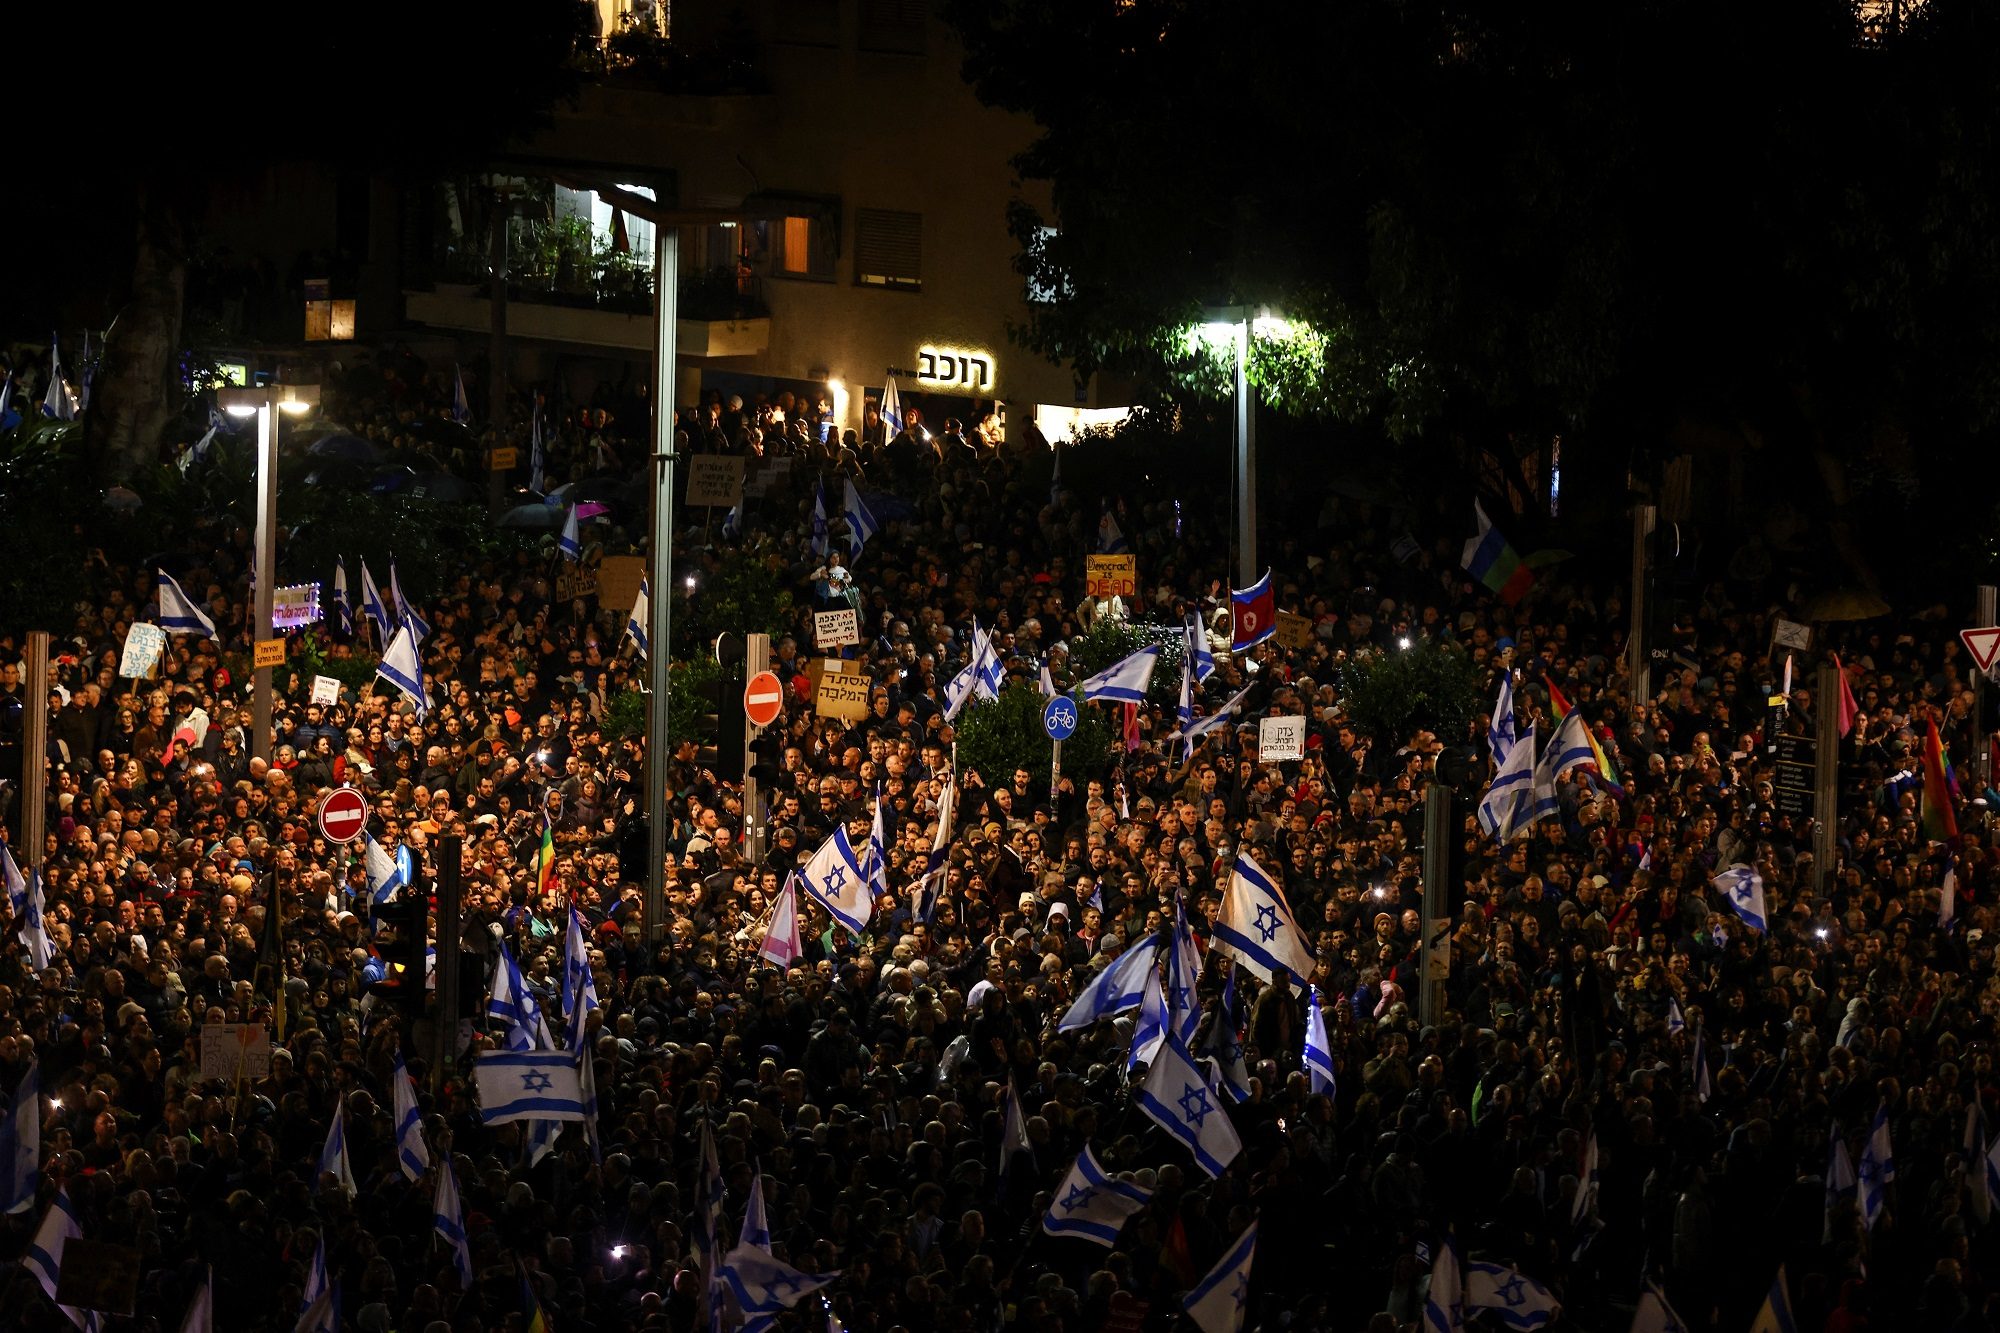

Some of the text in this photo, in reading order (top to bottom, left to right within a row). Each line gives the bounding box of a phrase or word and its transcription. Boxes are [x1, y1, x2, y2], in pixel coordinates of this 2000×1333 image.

[919, 352, 987, 385] רוכב
[1087, 580, 1134, 596] DEAD
[842, 611, 854, 619] לא
[826, 674, 870, 687] אסתר
[1277, 726, 1294, 739] צדק
